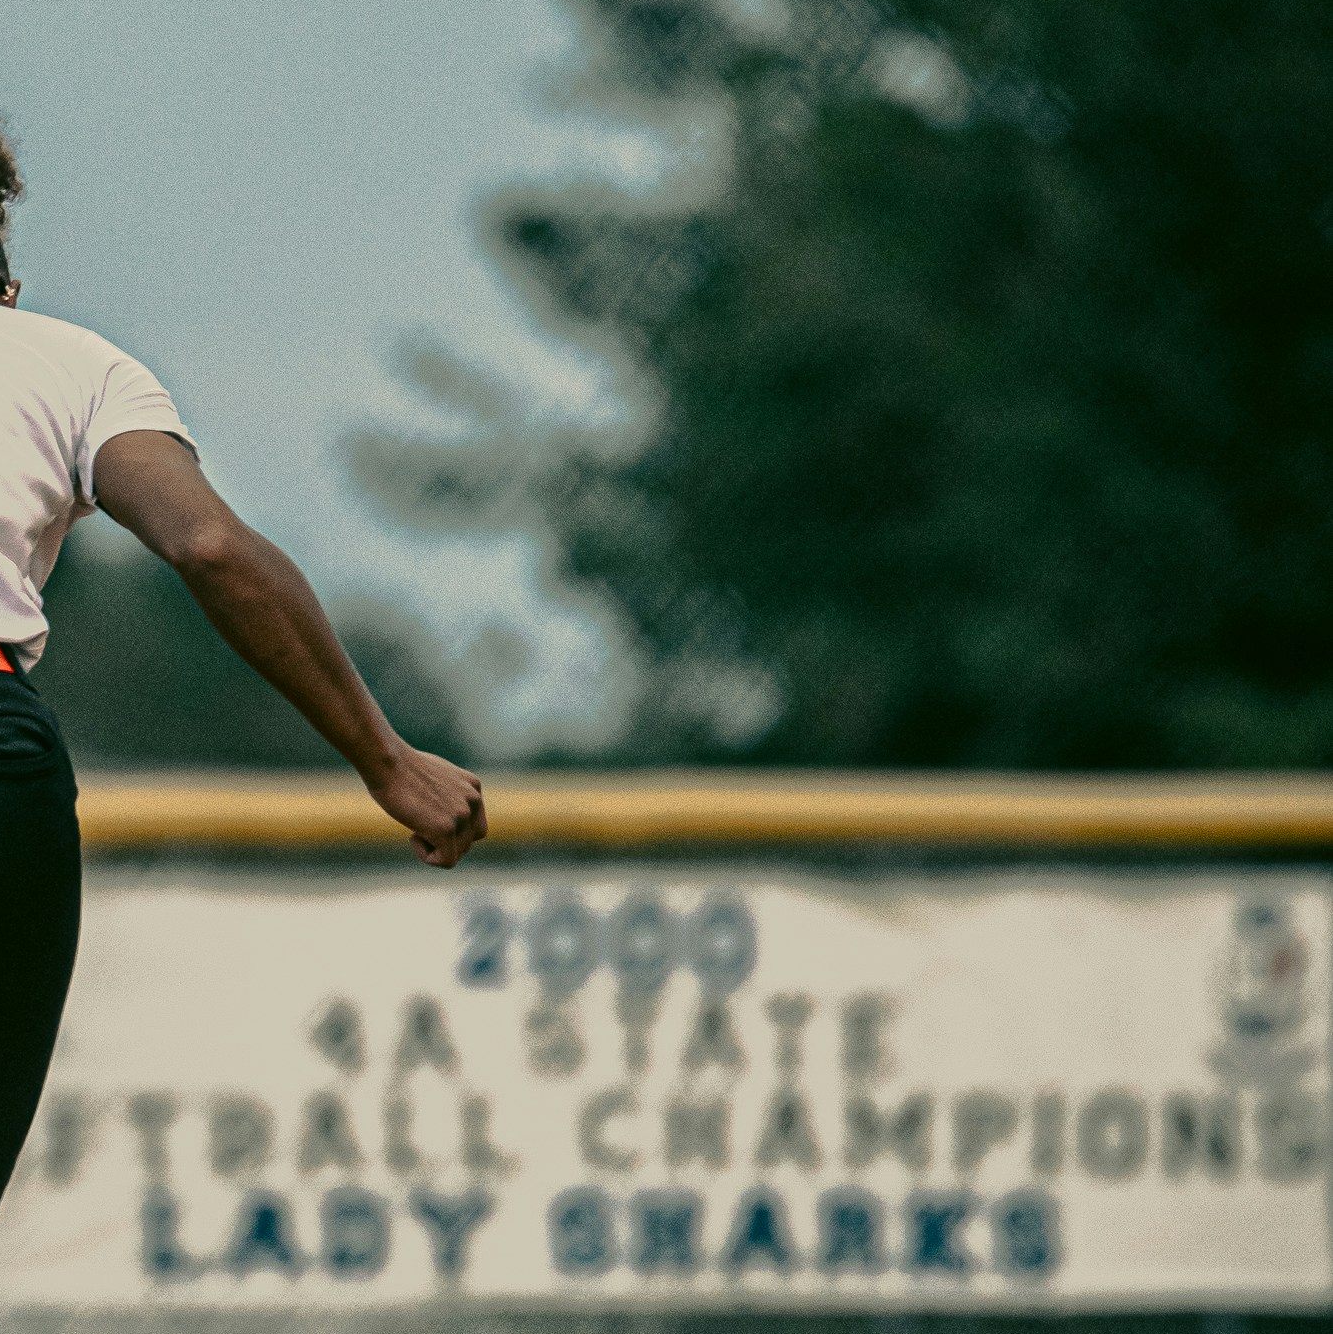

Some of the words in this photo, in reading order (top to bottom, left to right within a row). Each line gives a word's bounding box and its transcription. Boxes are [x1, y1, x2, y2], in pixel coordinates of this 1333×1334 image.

[459, 889, 755, 991] 2000
[309, 995, 463, 1075] 4A
[524, 991, 898, 1077] STATE
[18, 1093, 519, 1183] FTBALL
[577, 1092, 1328, 1183] CHAMPIONS
[141, 1187, 494, 1285] LADY
[547, 1186, 1063, 1277] SHARKS
